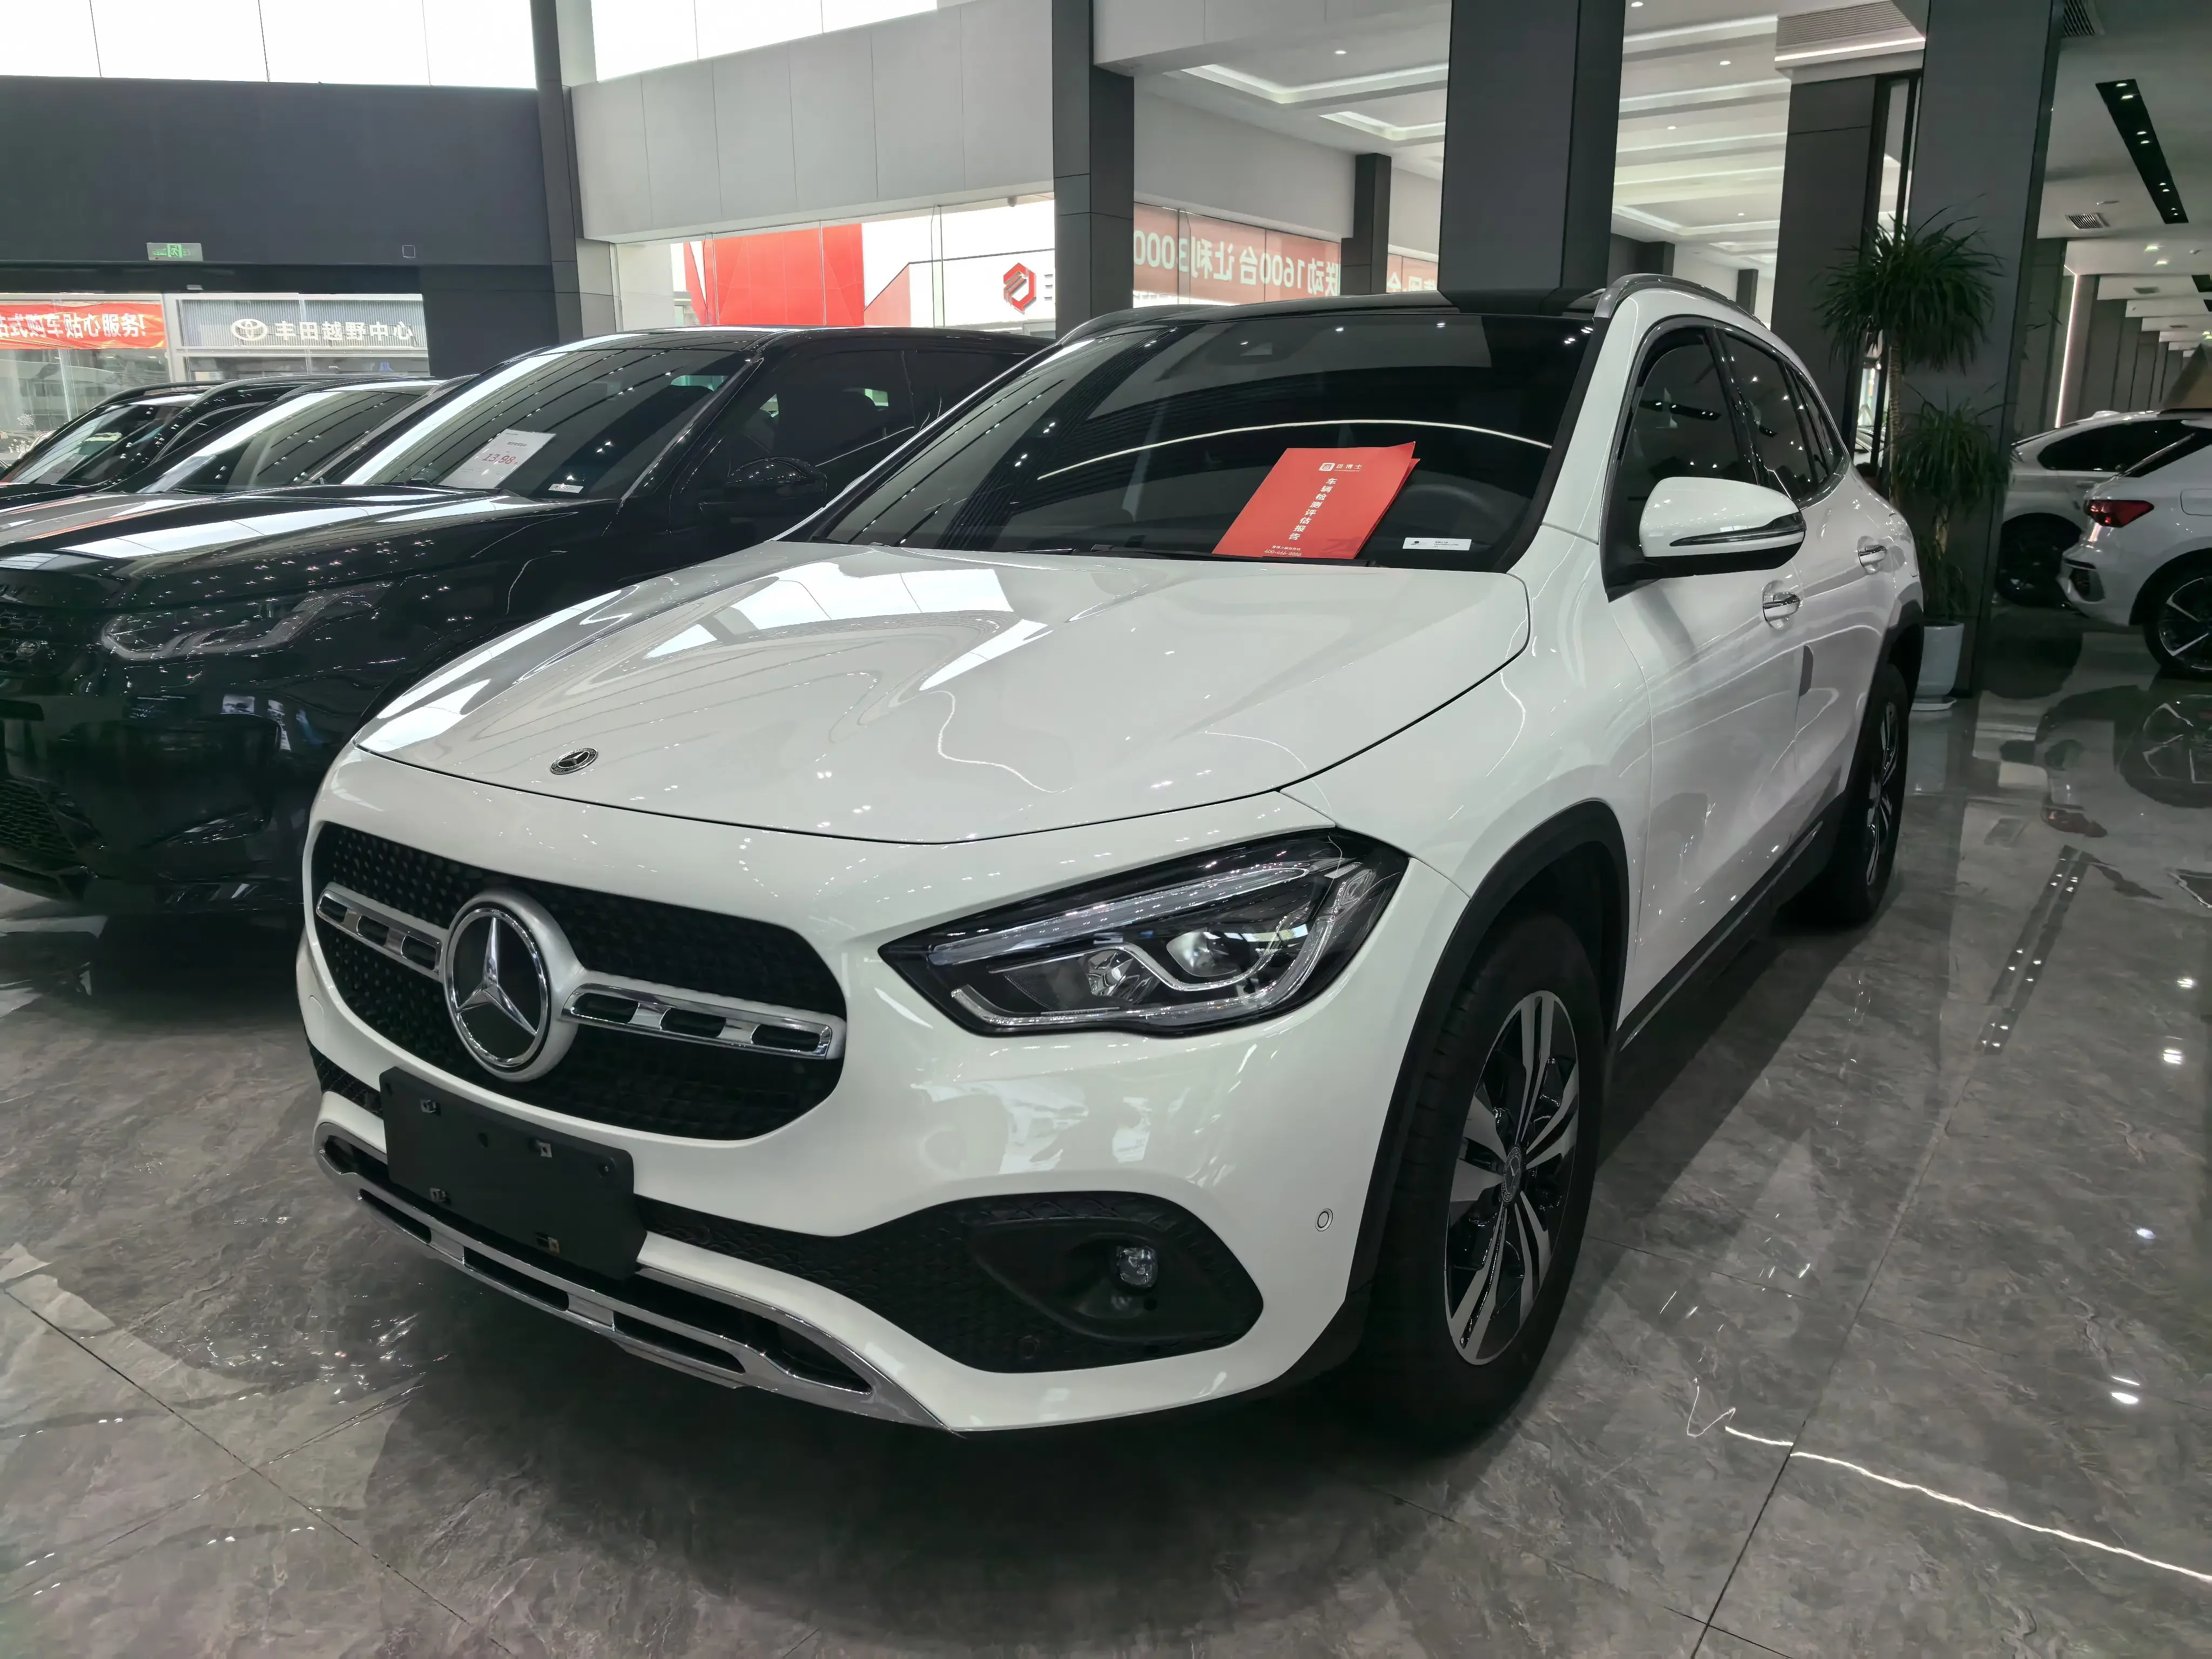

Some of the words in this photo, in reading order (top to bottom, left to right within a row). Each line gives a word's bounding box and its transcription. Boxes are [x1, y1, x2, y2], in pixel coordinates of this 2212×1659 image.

[275, 321, 414, 341] 丰田越野中心
[1289, 478, 1337, 541] 车辆检测评估报告
